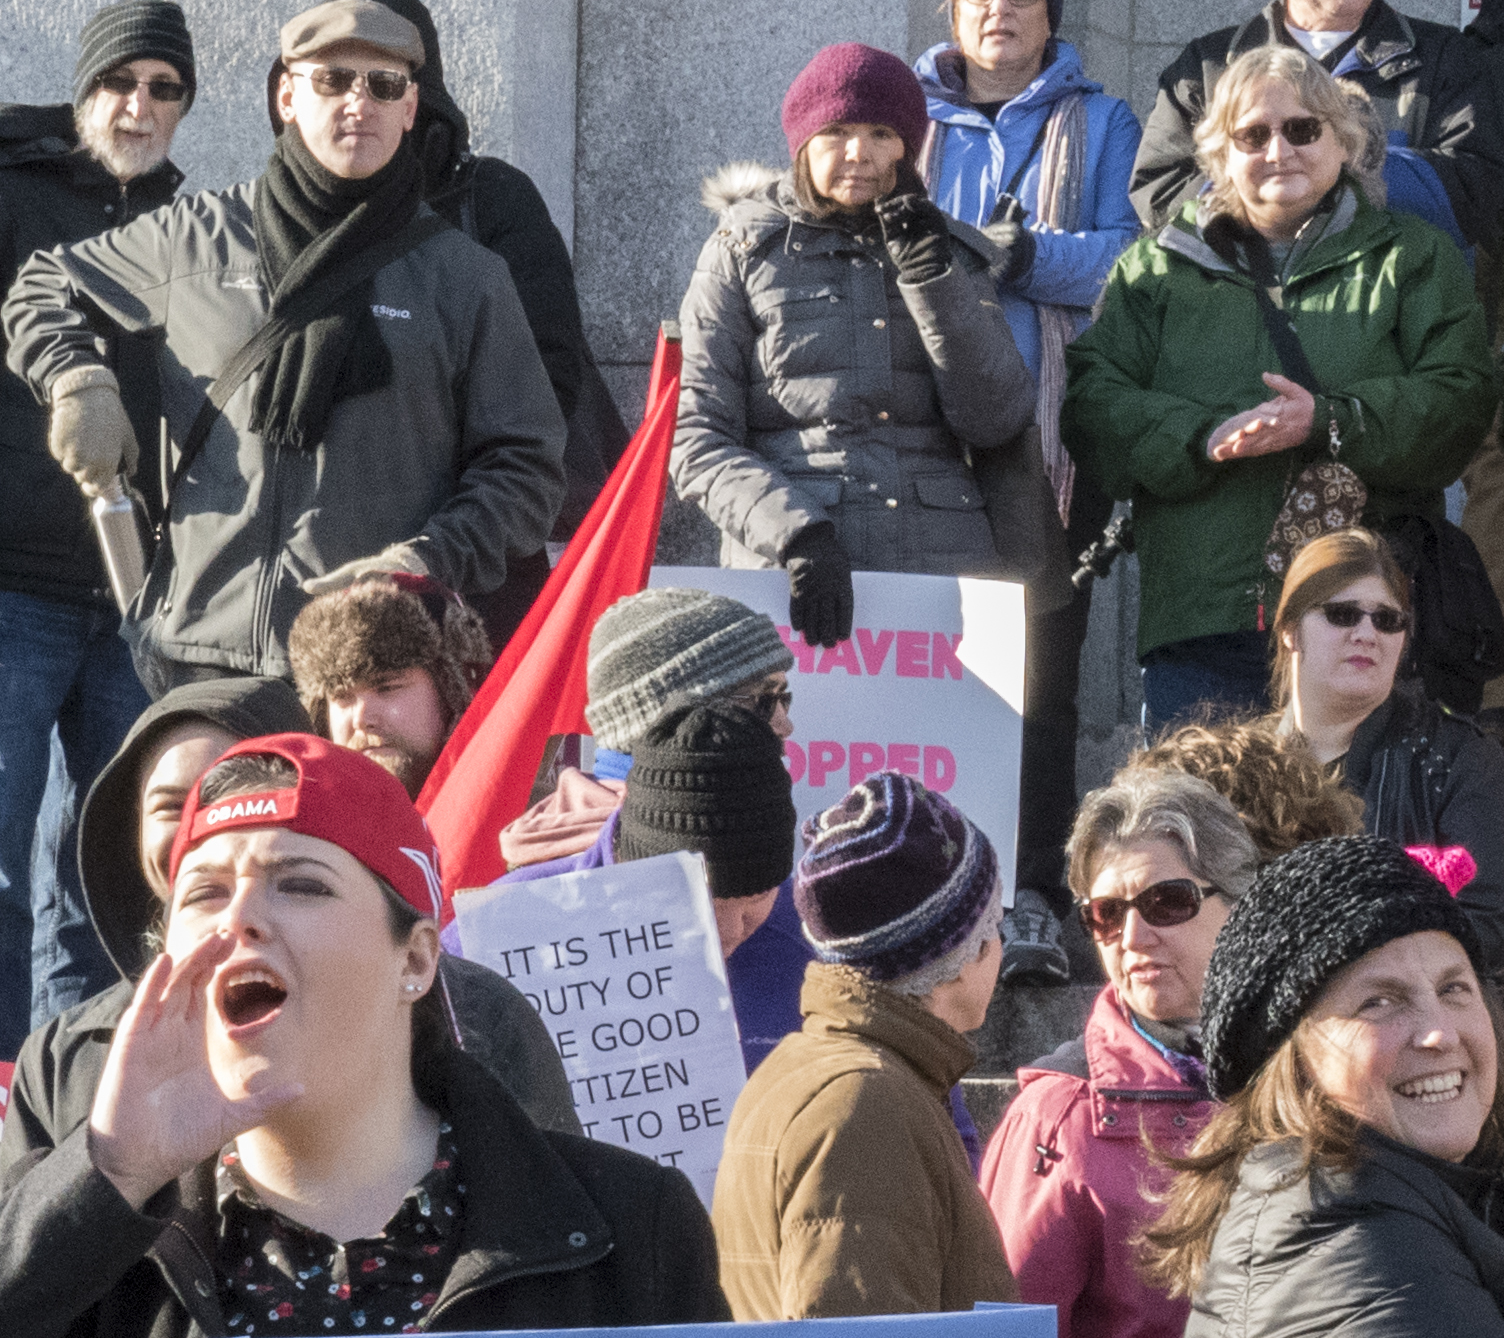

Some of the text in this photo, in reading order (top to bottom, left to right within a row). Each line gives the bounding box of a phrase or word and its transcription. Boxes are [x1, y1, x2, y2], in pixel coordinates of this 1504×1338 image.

[206, 798, 279, 826] OBAMA
[500, 920, 674, 978] IT IS THE
[626, 966, 674, 1000] OF
[591, 1008, 701, 1052] GOOD
[571, 1058, 690, 1107] ITIZEN
[612, 1098, 725, 1144] TO BE
